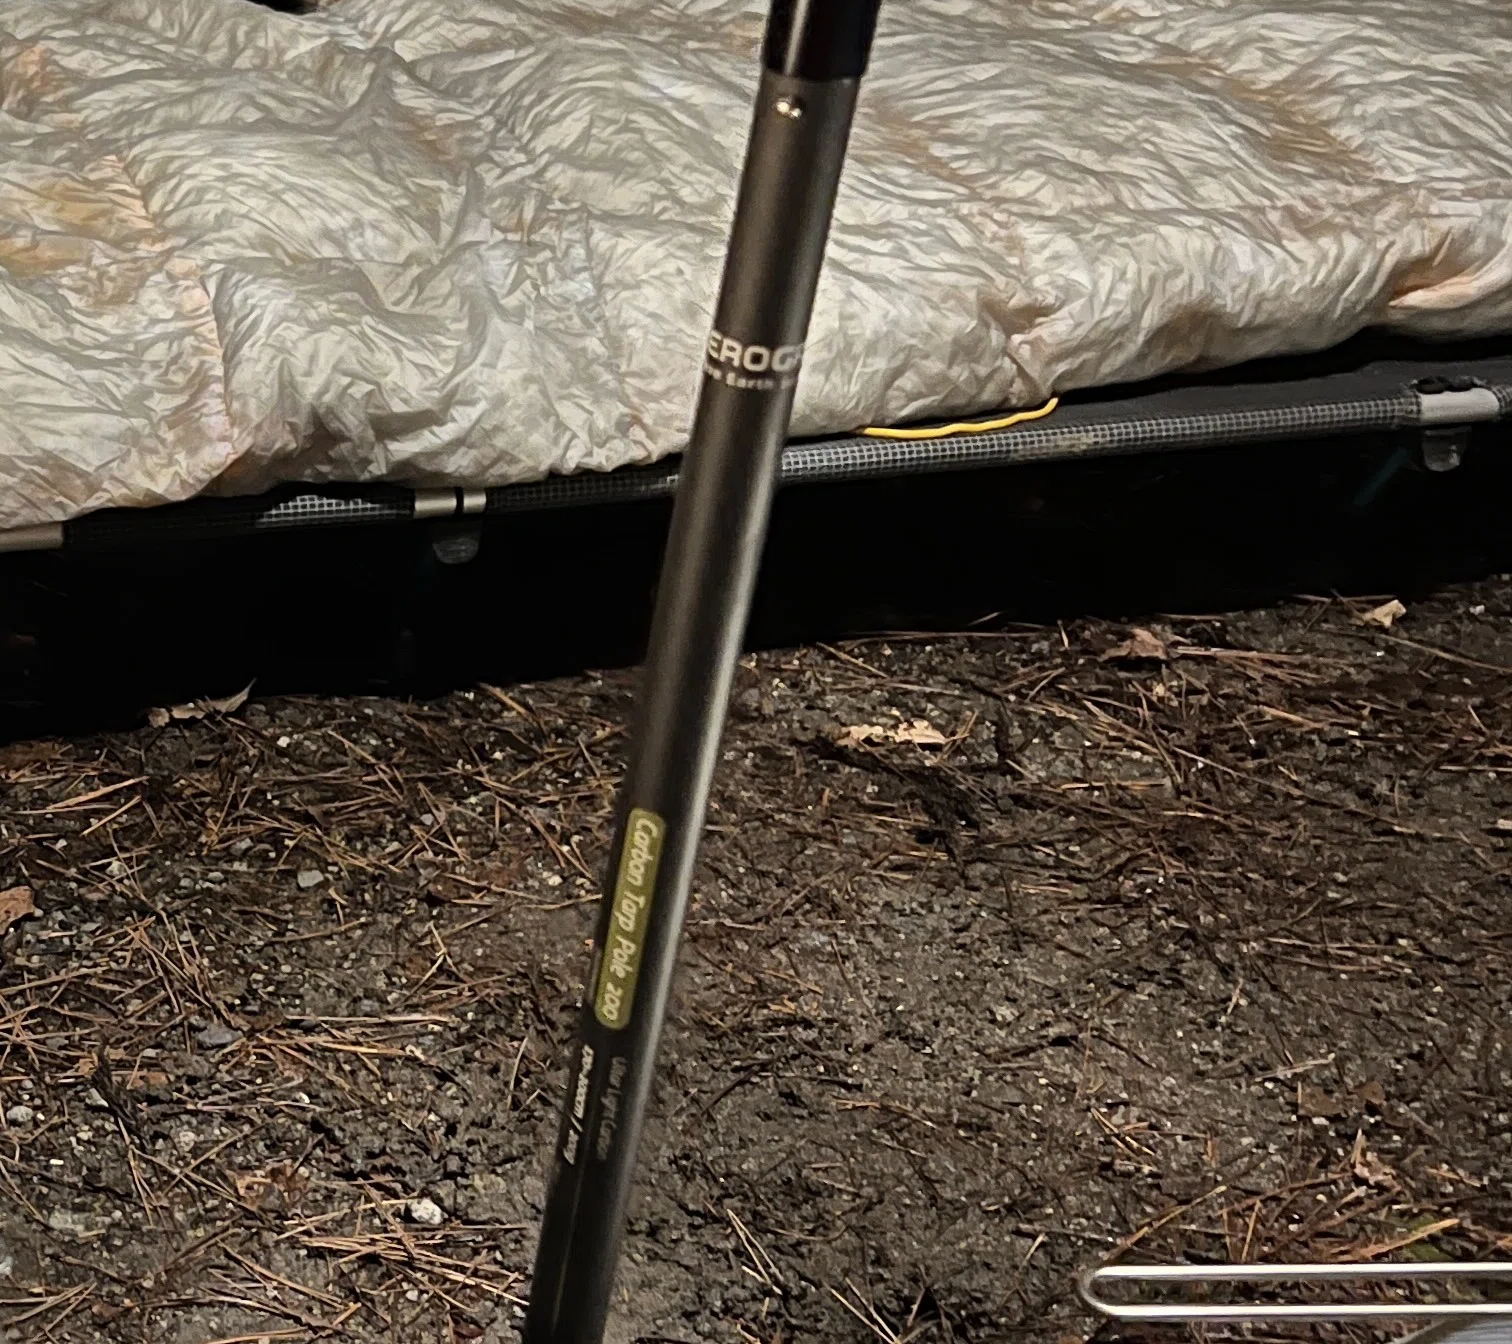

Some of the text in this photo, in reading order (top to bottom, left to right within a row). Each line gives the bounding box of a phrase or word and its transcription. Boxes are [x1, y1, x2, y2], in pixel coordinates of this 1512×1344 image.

[707, 329, 804, 372] EROG
[600, 817, 659, 1022] Carbon Tarp Pole 200
